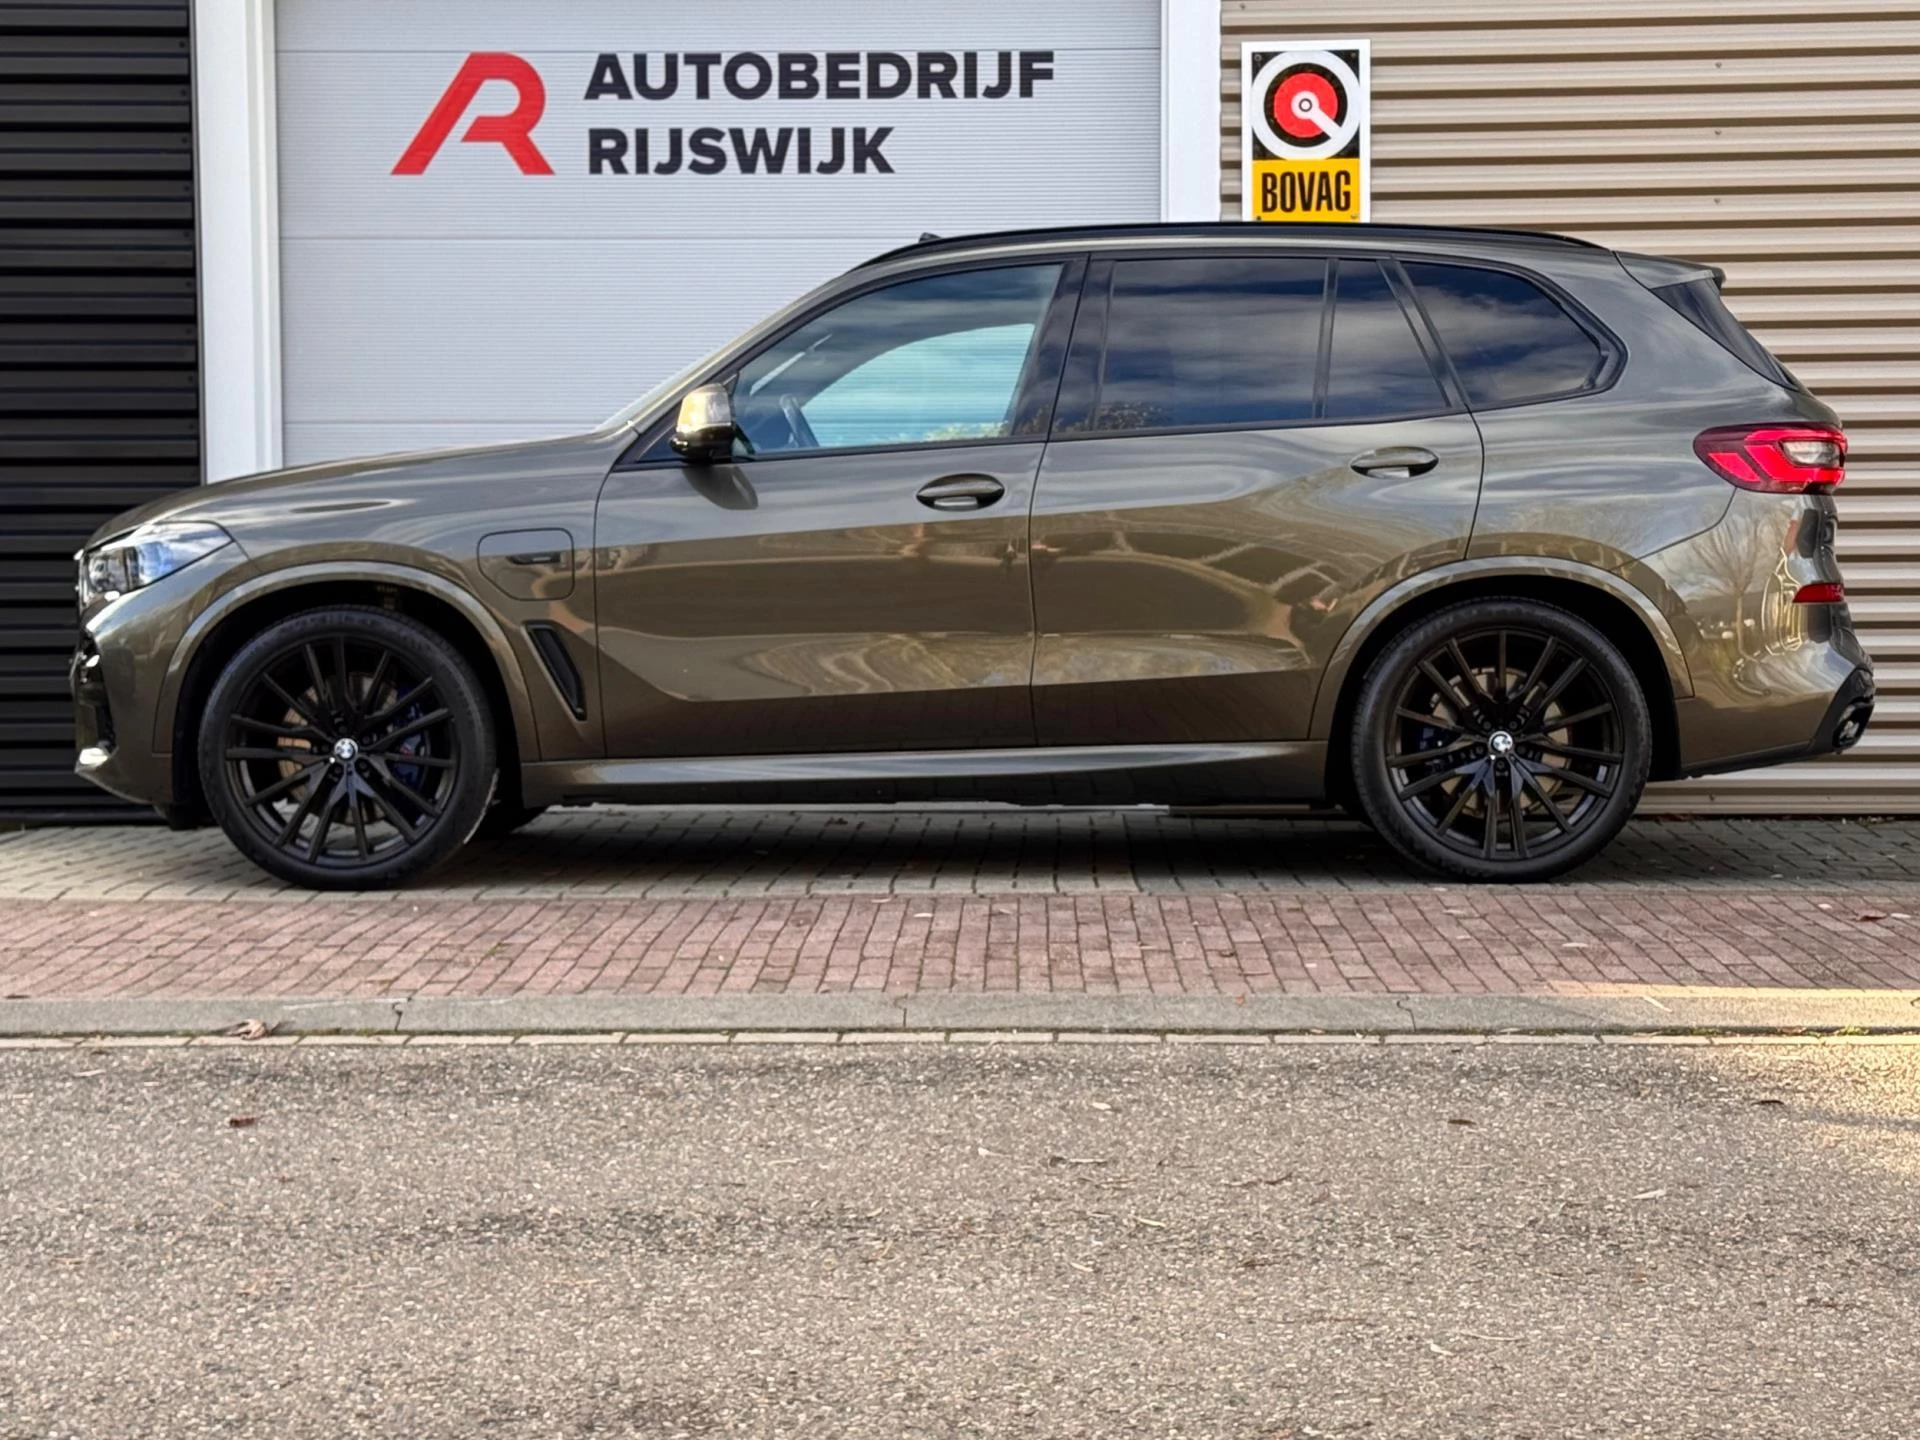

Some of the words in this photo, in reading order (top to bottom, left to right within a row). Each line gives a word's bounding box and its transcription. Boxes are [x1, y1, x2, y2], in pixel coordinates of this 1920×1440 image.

[584, 50, 1054, 101] AUTOBEDRIJF
[588, 126, 895, 175] RIJSWIJK
[1261, 170, 1351, 213] BOVAG
